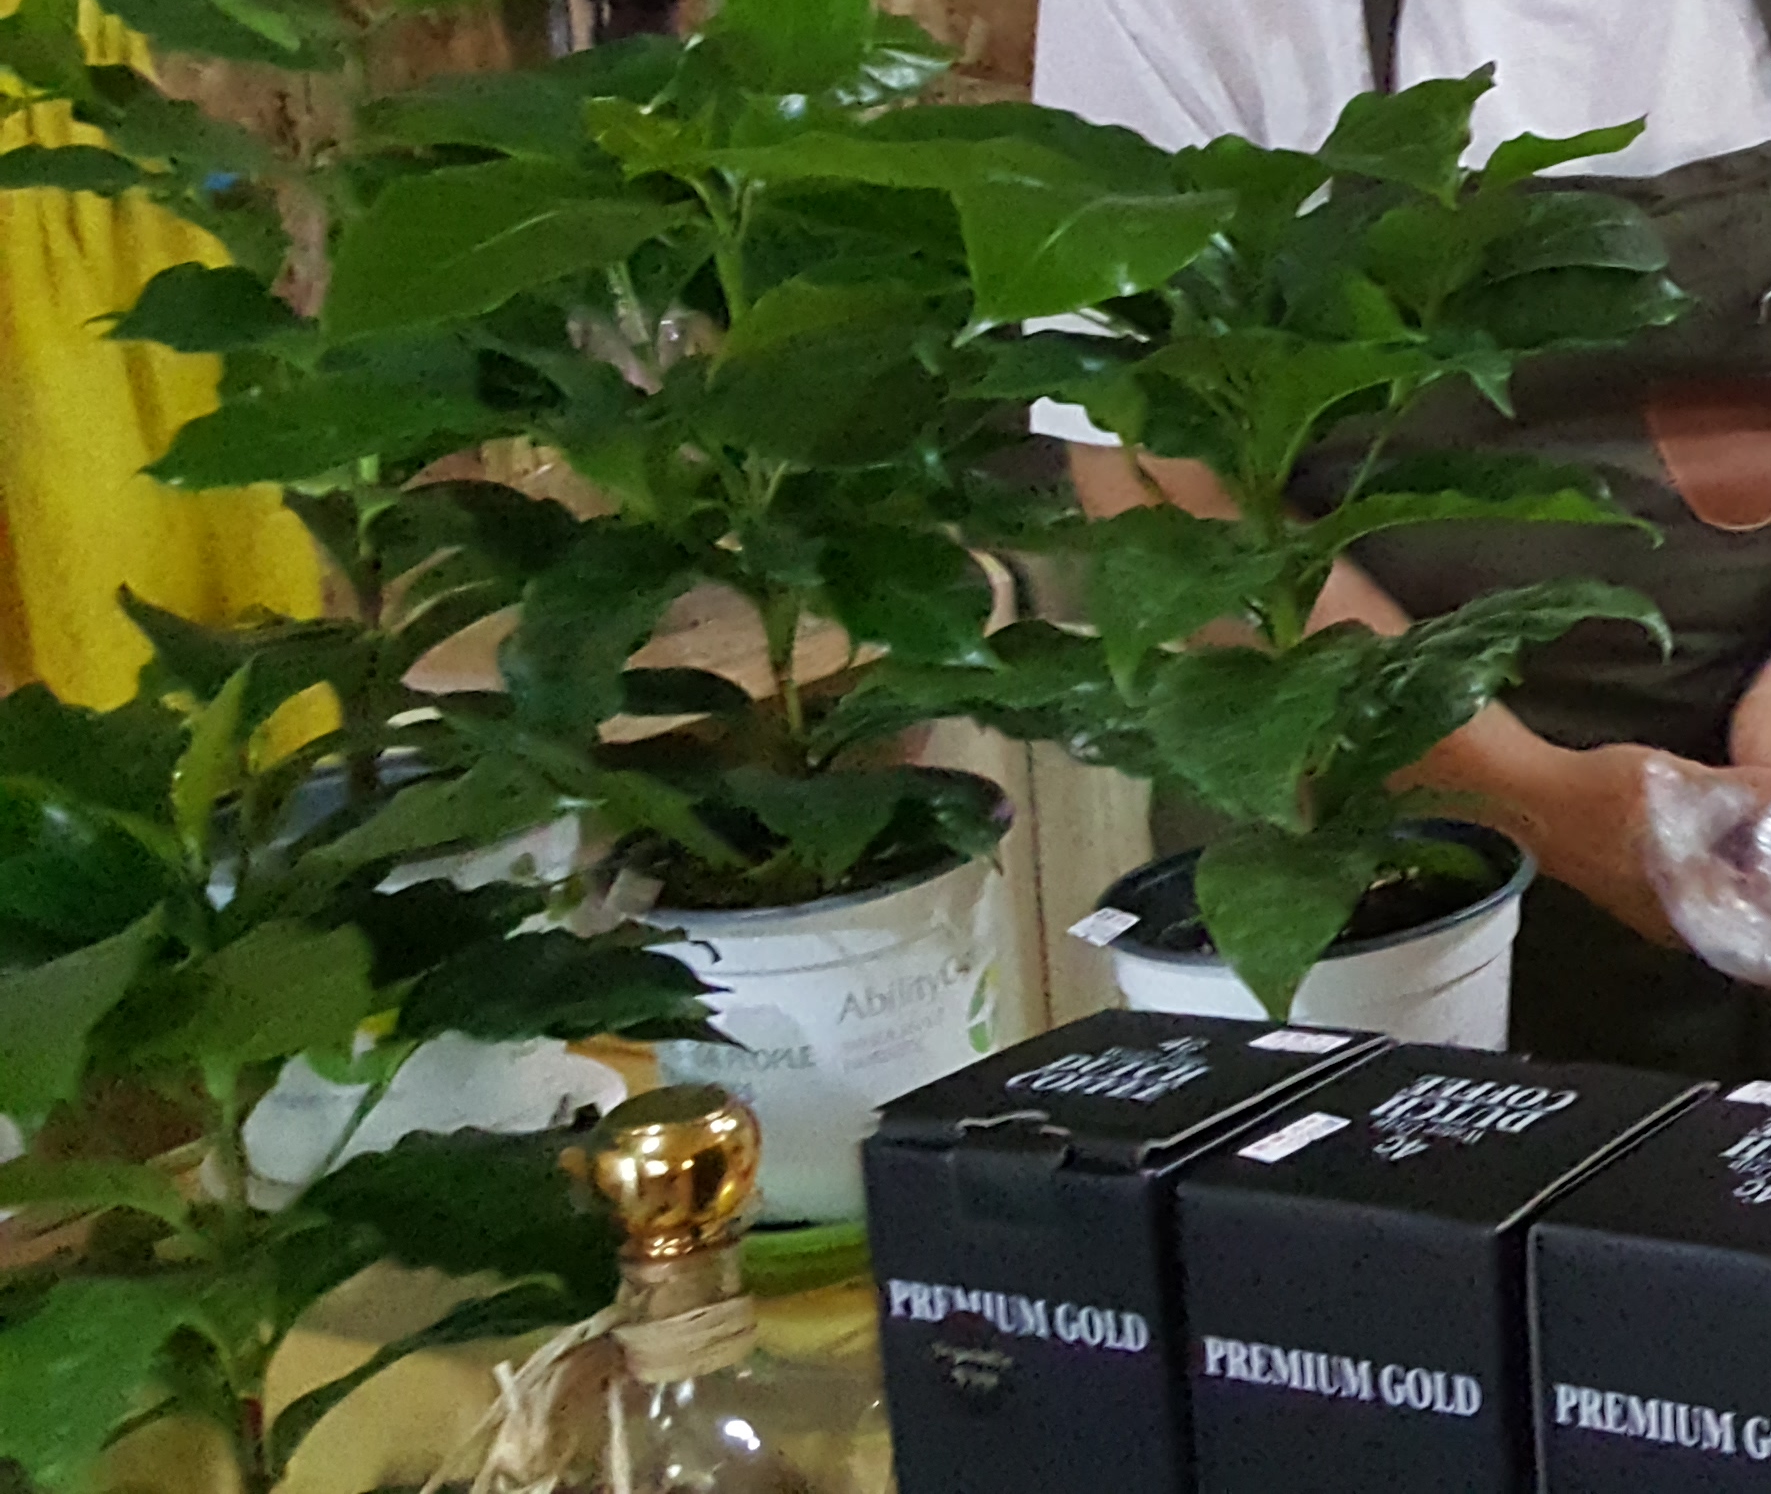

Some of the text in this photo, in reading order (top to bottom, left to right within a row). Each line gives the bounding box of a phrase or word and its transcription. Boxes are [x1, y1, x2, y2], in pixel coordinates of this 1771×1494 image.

[888, 1278, 1150, 1353] PREMIUM GOLD
[1202, 1334, 1484, 1417] PREMIUM GOLD
[1553, 1382, 1738, 1454] PREMIUM
